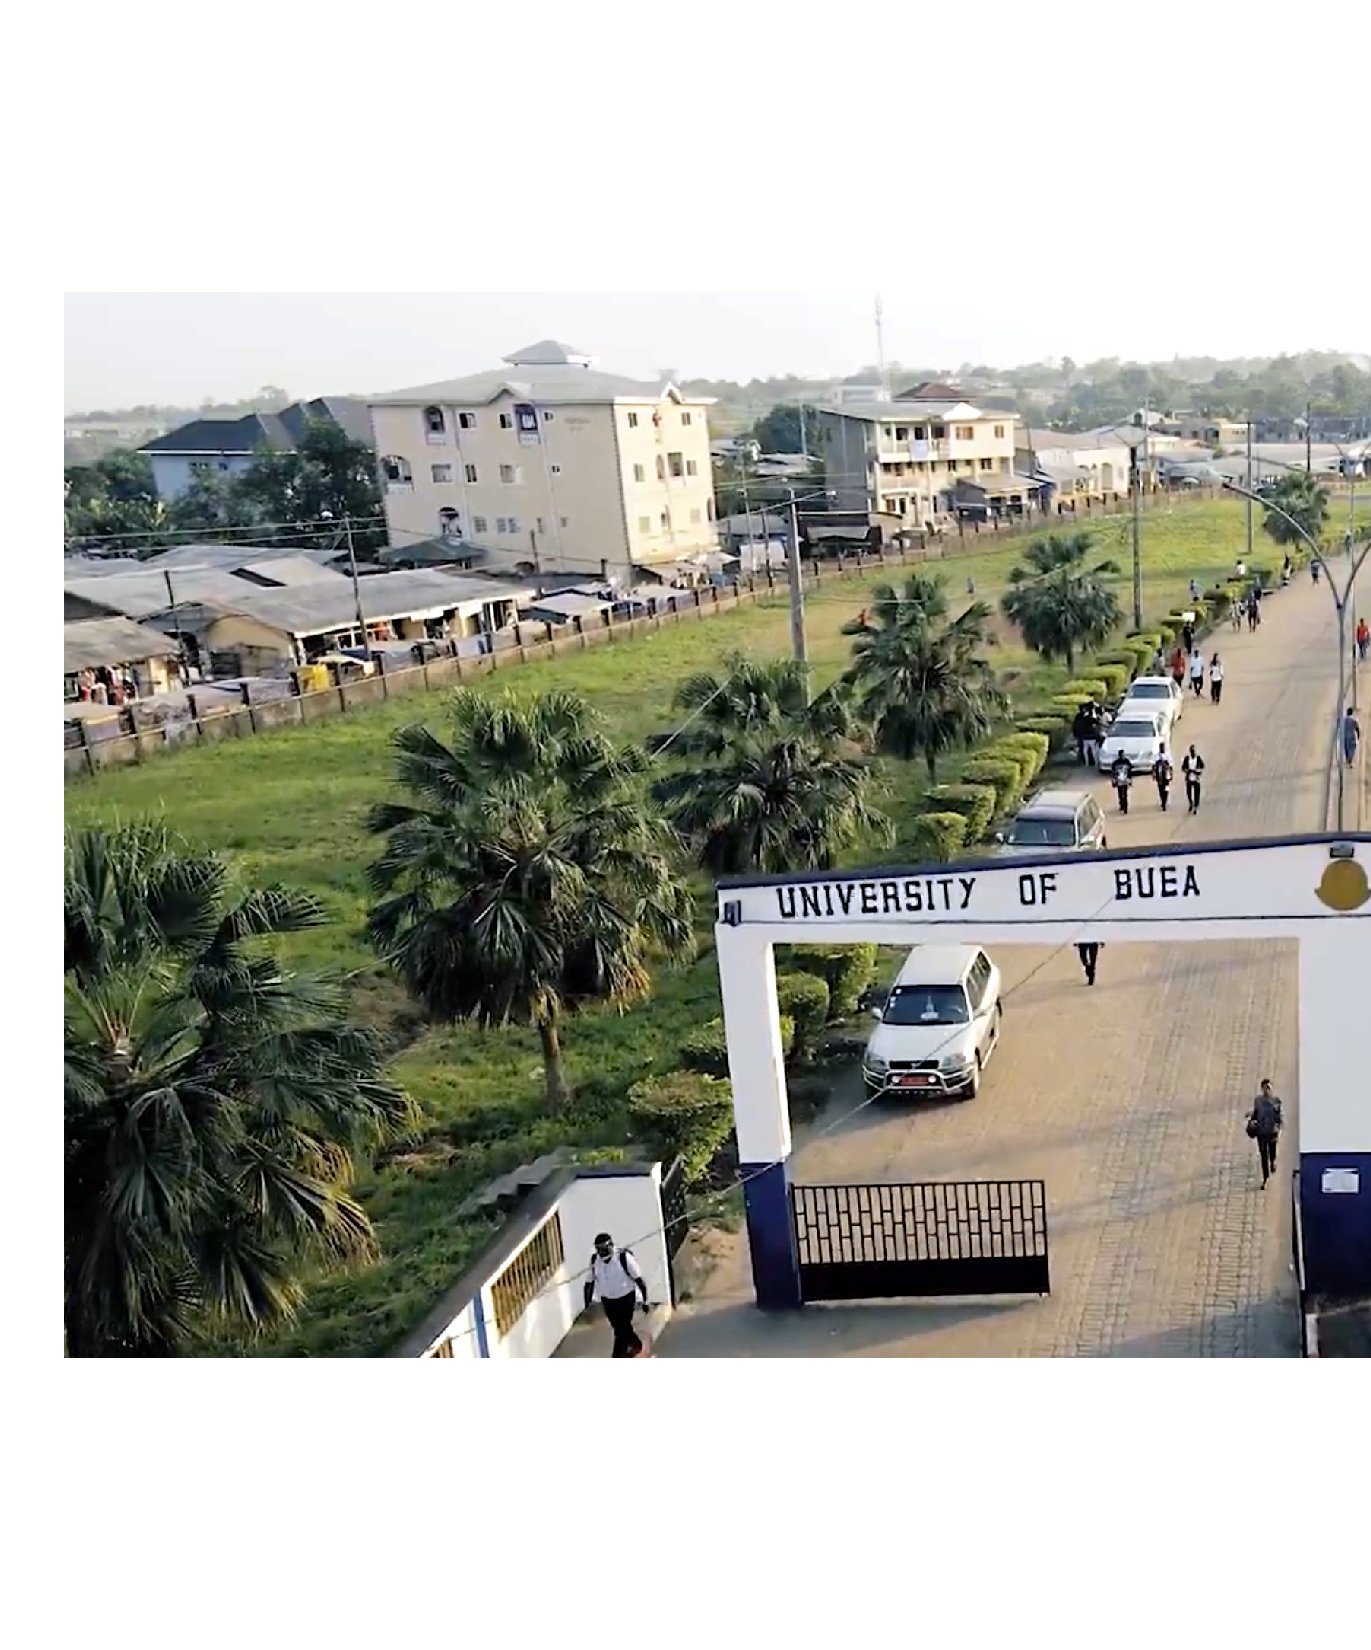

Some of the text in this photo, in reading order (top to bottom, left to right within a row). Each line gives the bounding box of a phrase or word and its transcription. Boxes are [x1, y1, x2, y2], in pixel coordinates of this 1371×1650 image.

[776, 864, 1201, 919] UNIVERSITY OF BUEA
